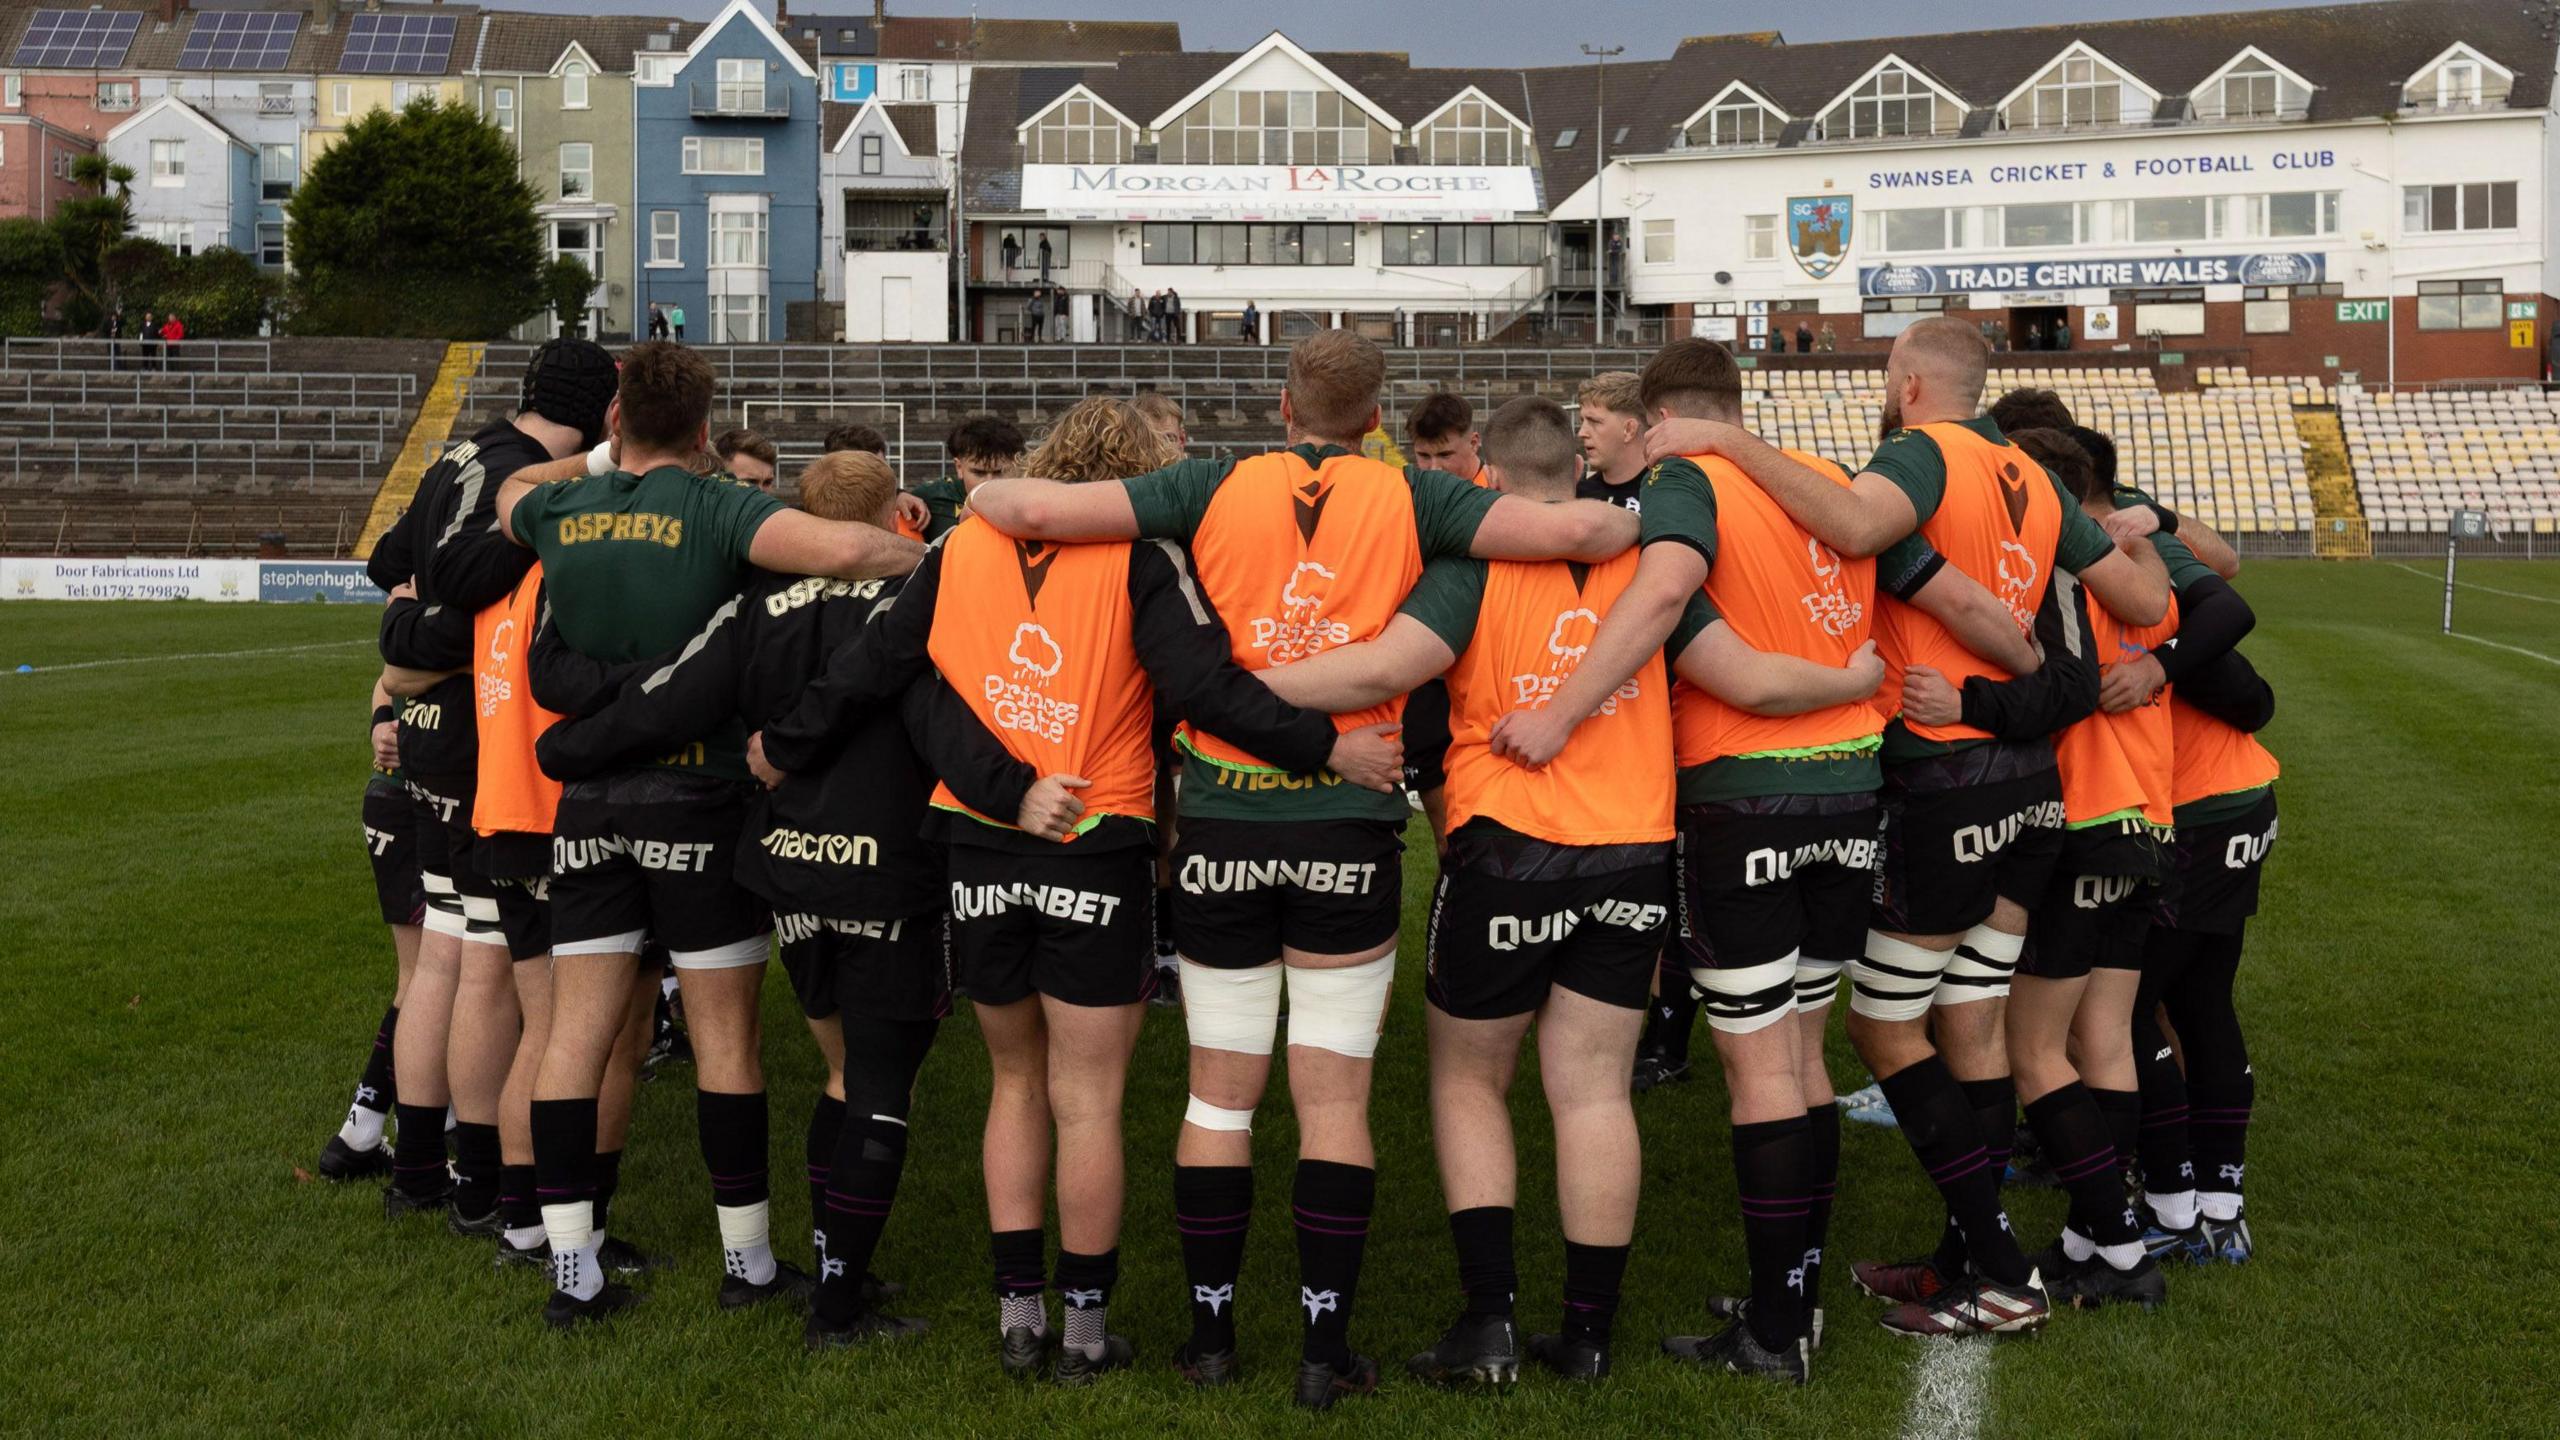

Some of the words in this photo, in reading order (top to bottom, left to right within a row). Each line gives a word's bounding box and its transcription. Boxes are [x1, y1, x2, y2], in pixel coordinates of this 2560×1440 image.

[1068, 167, 1270, 192] MORGAN
[1869, 169, 1974, 189] SWANSEA
[1990, 163, 2088, 184] CRICKET
[2103, 162, 2117, 178] &
[2135, 155, 2254, 176] FOOTBALL
[2273, 150, 2335, 170] CLUB
[1792, 204, 1811, 216] SC
[1831, 202, 1848, 214] FC
[1946, 266, 2027, 292] TRADE
[2035, 263, 2132, 289] CENTRE
[2139, 260, 2229, 285] WALES
[2338, 301, 2387, 321] EXIT
[2517, 331, 2525, 345] 1
[560, 512, 682, 548] OSPREYS
[55, 565, 88, 578] Door
[92, 565, 175, 578] Fabrications
[178, 565, 199, 578] Ltd
[65, 584, 89, 597] Tel:
[92, 584, 135, 597] 01792
[139, 585, 190, 598] 799829
[985, 675, 1080, 726] Princes
[994, 699, 1065, 744] Gate
[760, 828, 878, 867] macron
[1180, 854, 1377, 894] QUINNBET
[1676, 857, 1686, 889] BAR
[952, 881, 1121, 926] QUINNBET
[1432, 898, 1445, 929] BAR
[1678, 891, 1692, 938] DOOM
